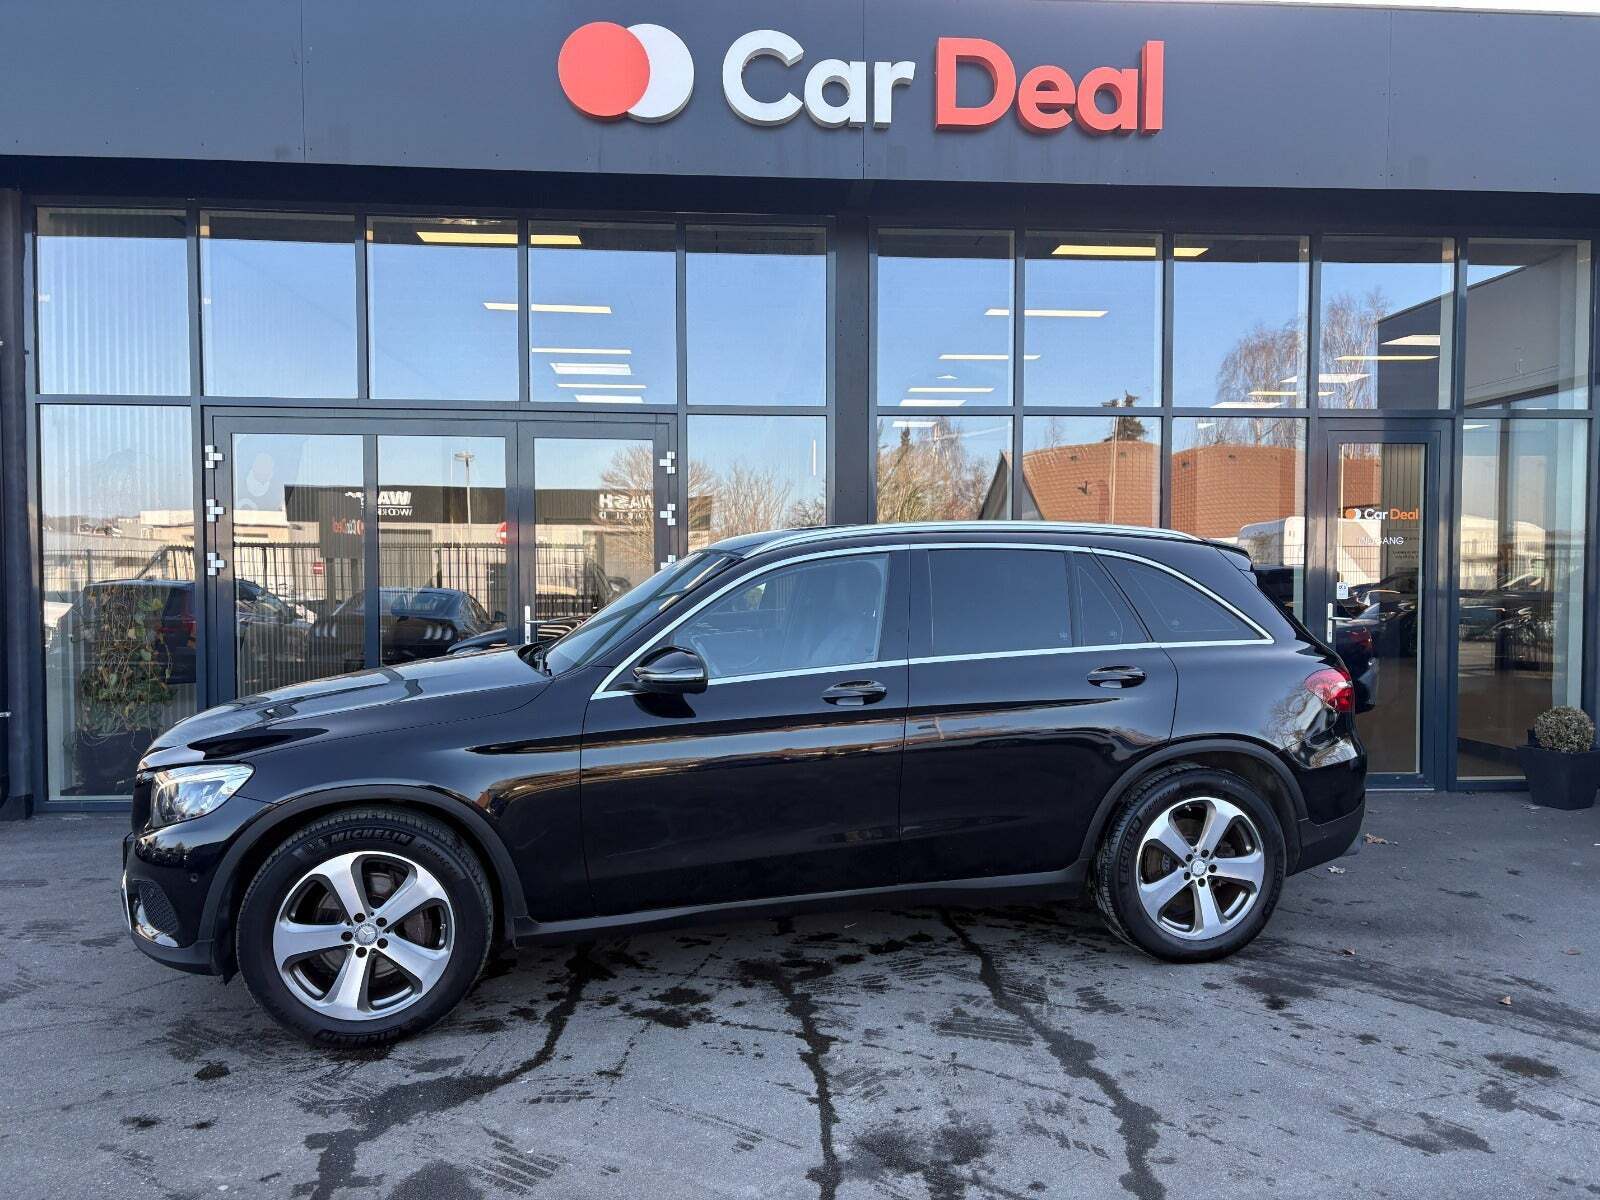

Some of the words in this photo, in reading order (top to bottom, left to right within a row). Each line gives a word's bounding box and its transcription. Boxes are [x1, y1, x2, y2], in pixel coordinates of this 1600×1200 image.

[722, 29, 916, 129] Car
[935, 37, 1166, 136] Deal
[1364, 508, 1388, 520] Car
[1390, 508, 1419, 520] Deal
[331, 829, 412, 843] MICHELIN
